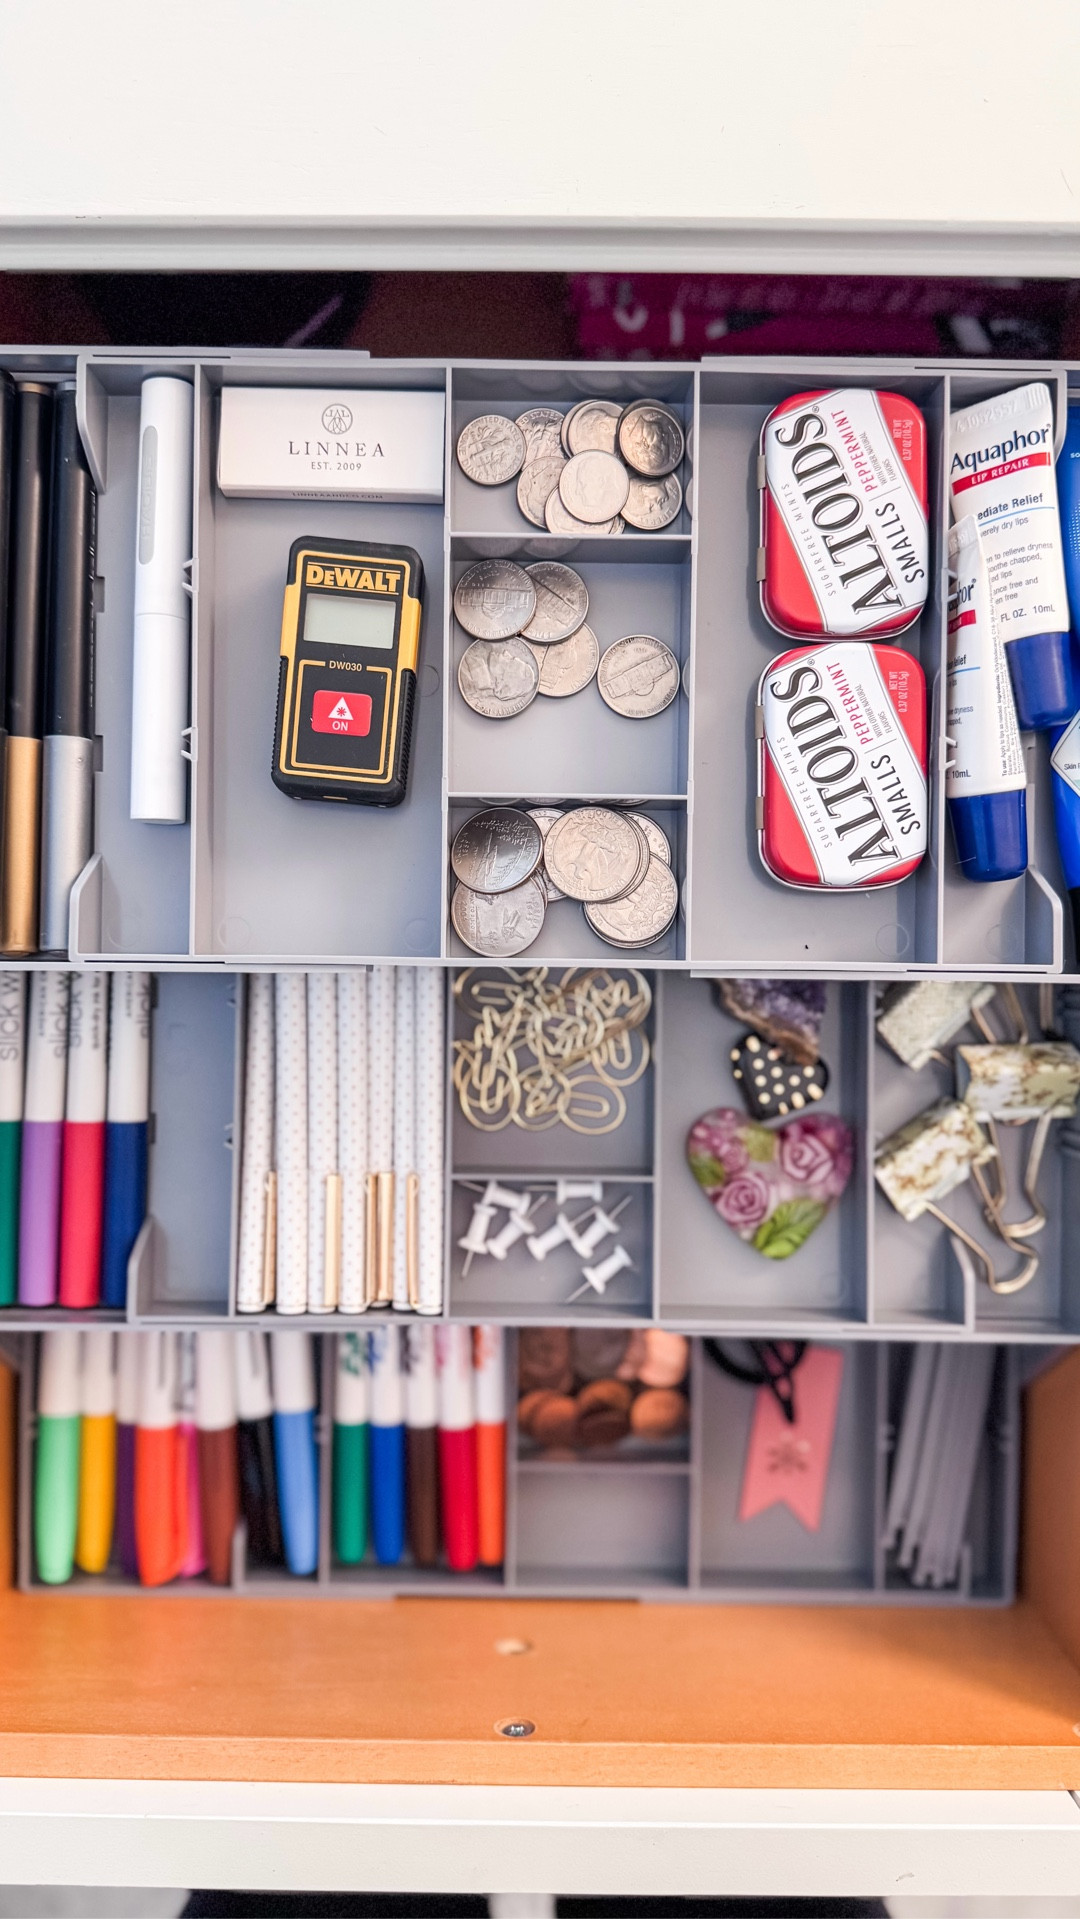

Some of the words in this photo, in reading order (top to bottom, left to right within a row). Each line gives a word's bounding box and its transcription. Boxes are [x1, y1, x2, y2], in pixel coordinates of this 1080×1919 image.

[859, 431, 874, 455] NATURAL
[893, 428, 902, 439] NET
[288, 440, 385, 458] LINNEA
[831, 410, 878, 493] PEPPERMINT
[950, 428, 1048, 475] Aquaphor
[311, 462, 332, 471] EST.
[337, 462, 362, 471] 2009
[869, 454, 882, 472] OTHER
[881, 458, 897, 481] FLAVORS
[971, 472, 988, 485] LIP
[991, 458, 1029, 478] REPAIR
[775, 413, 904, 614] ALTOIDS
[781, 483, 803, 522] MINTS
[977, 503, 1009, 520] ediate
[1011, 492, 1044, 509] Relief
[980, 525, 999, 537] erely
[1001, 520, 1013, 530] dry
[1015, 515, 1029, 526] lips
[875, 502, 925, 584] SMALLS
[994, 552, 1001, 560] to
[1003, 545, 1026, 558] relieve
[1027, 542, 1053, 554] dryness
[800, 527, 837, 596] SUGARFREE
[1010, 553, 1042, 567] chapped,
[306, 564, 400, 593] DEWALT
[1001, 569, 1013, 580] lips
[1009, 580, 1023, 590] free
[1025, 576, 1039, 586] and
[1004, 592, 1018, 601] free
[1000, 613, 1010, 622] FL
[1012, 608, 1027, 619] OZ.
[1033, 604, 1056, 614] 10mL
[329, 660, 362, 672] DW030
[855, 684, 870, 707] NATURAL
[888, 680, 898, 691] NET
[826, 662, 874, 746] PEPPERMINT
[865, 707, 877, 724] OTHER
[332, 720, 349, 731] ON
[877, 711, 893, 734] FLAVORS
[770, 666, 900, 865] ALTOIDS
[776, 736, 800, 775] MINTS
[1064, 763, 1076, 771] Skin
[952, 769, 971, 779] 10mL
[871, 754, 921, 836] SMALLS
[796, 781, 832, 848] SUGARFREE
